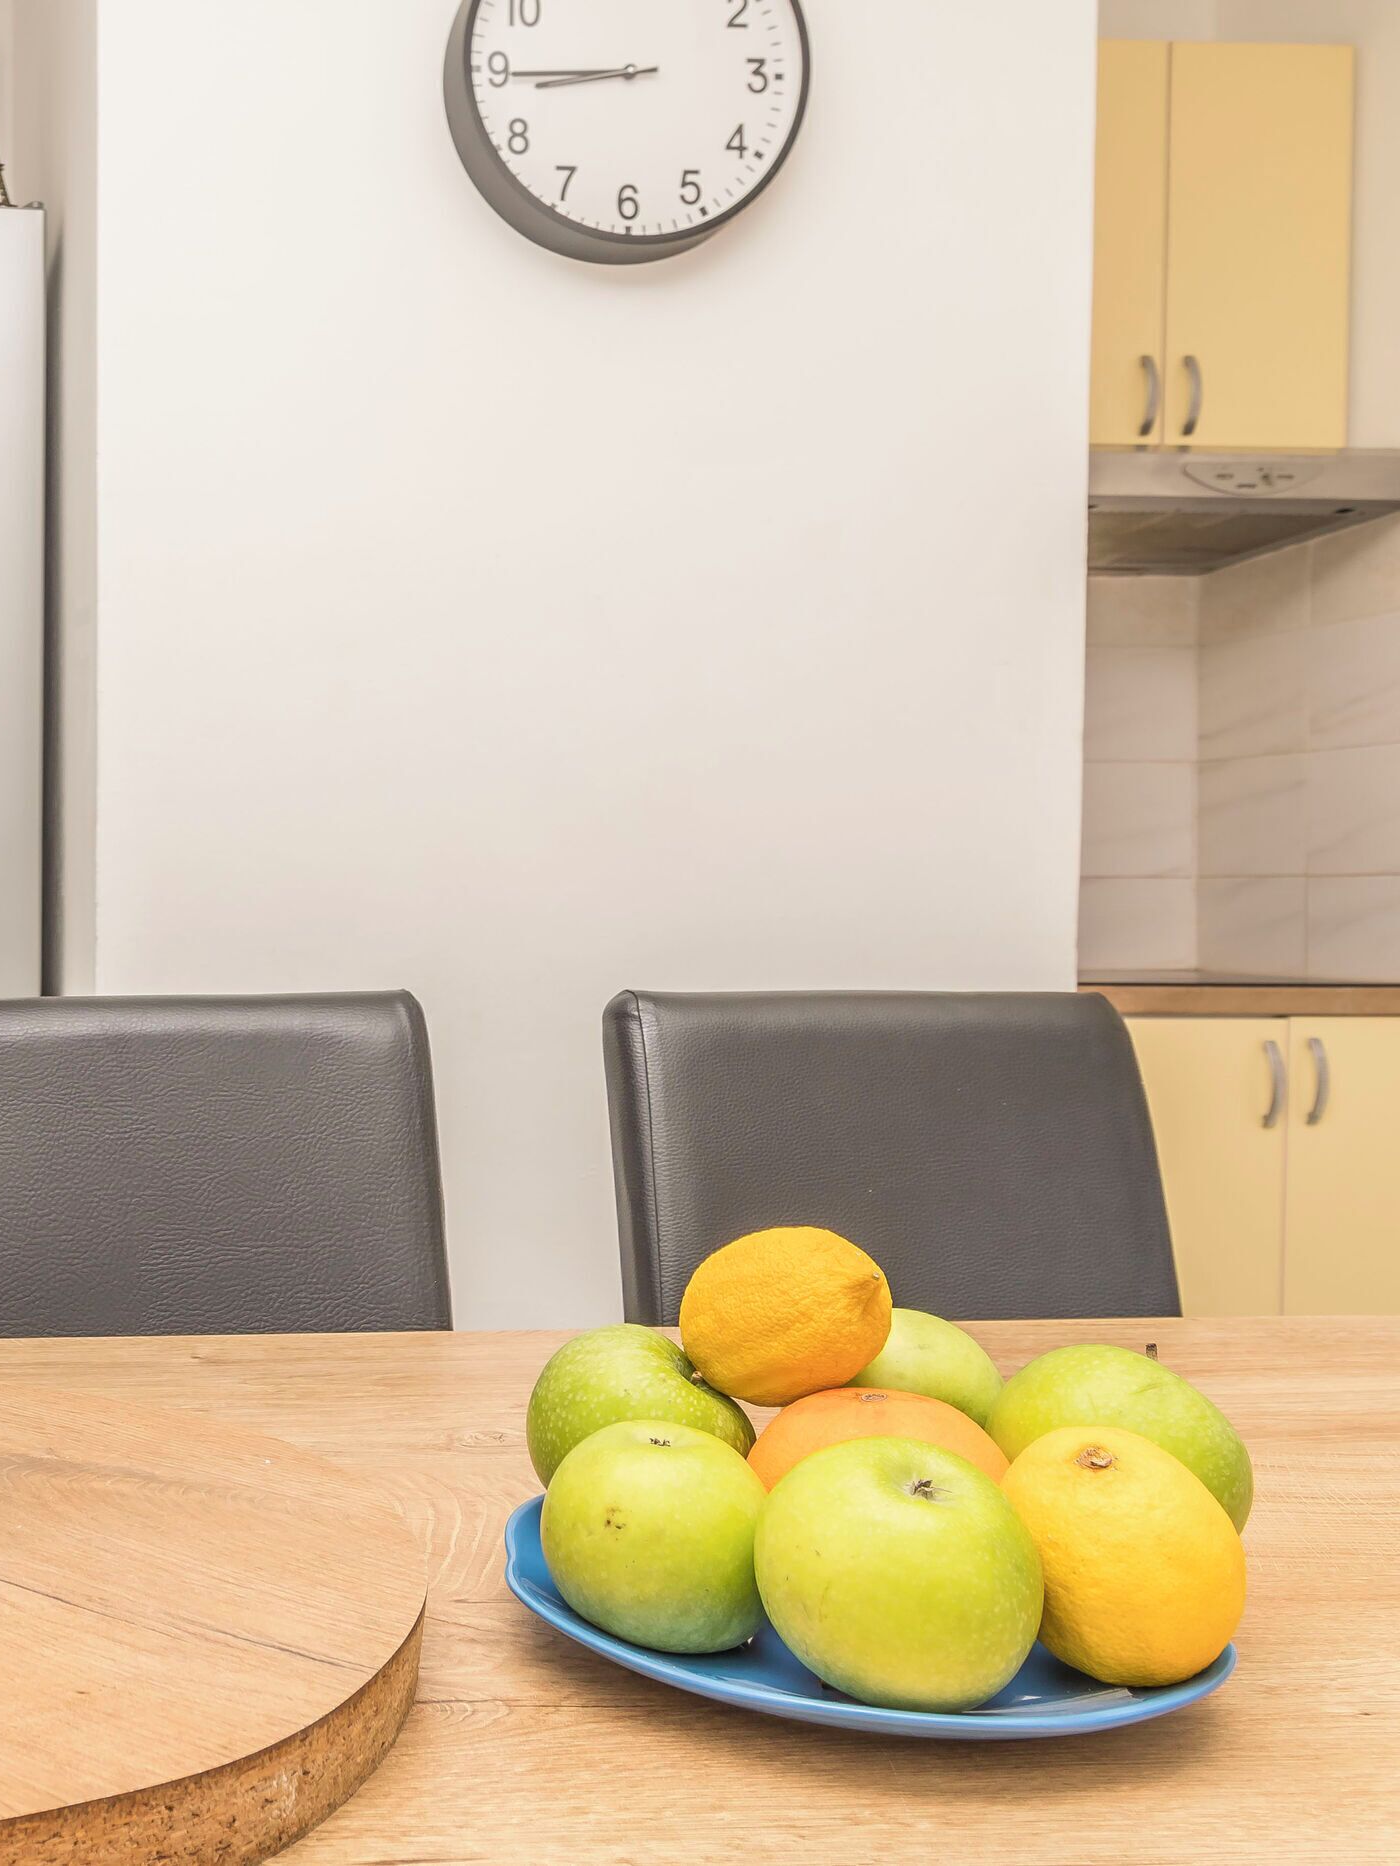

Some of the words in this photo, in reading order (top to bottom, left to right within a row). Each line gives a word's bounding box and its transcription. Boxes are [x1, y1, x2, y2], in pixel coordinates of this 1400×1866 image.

[509, 0, 541, 28] 10
[727, 0, 749, 28] 2
[487, 51, 510, 88] 9
[746, 58, 768, 94] 3
[507, 118, 529, 155] 8
[725, 124, 748, 159] 4
[555, 165, 578, 201] 7
[679, 169, 701, 205] 5
[617, 184, 639, 220] 6
